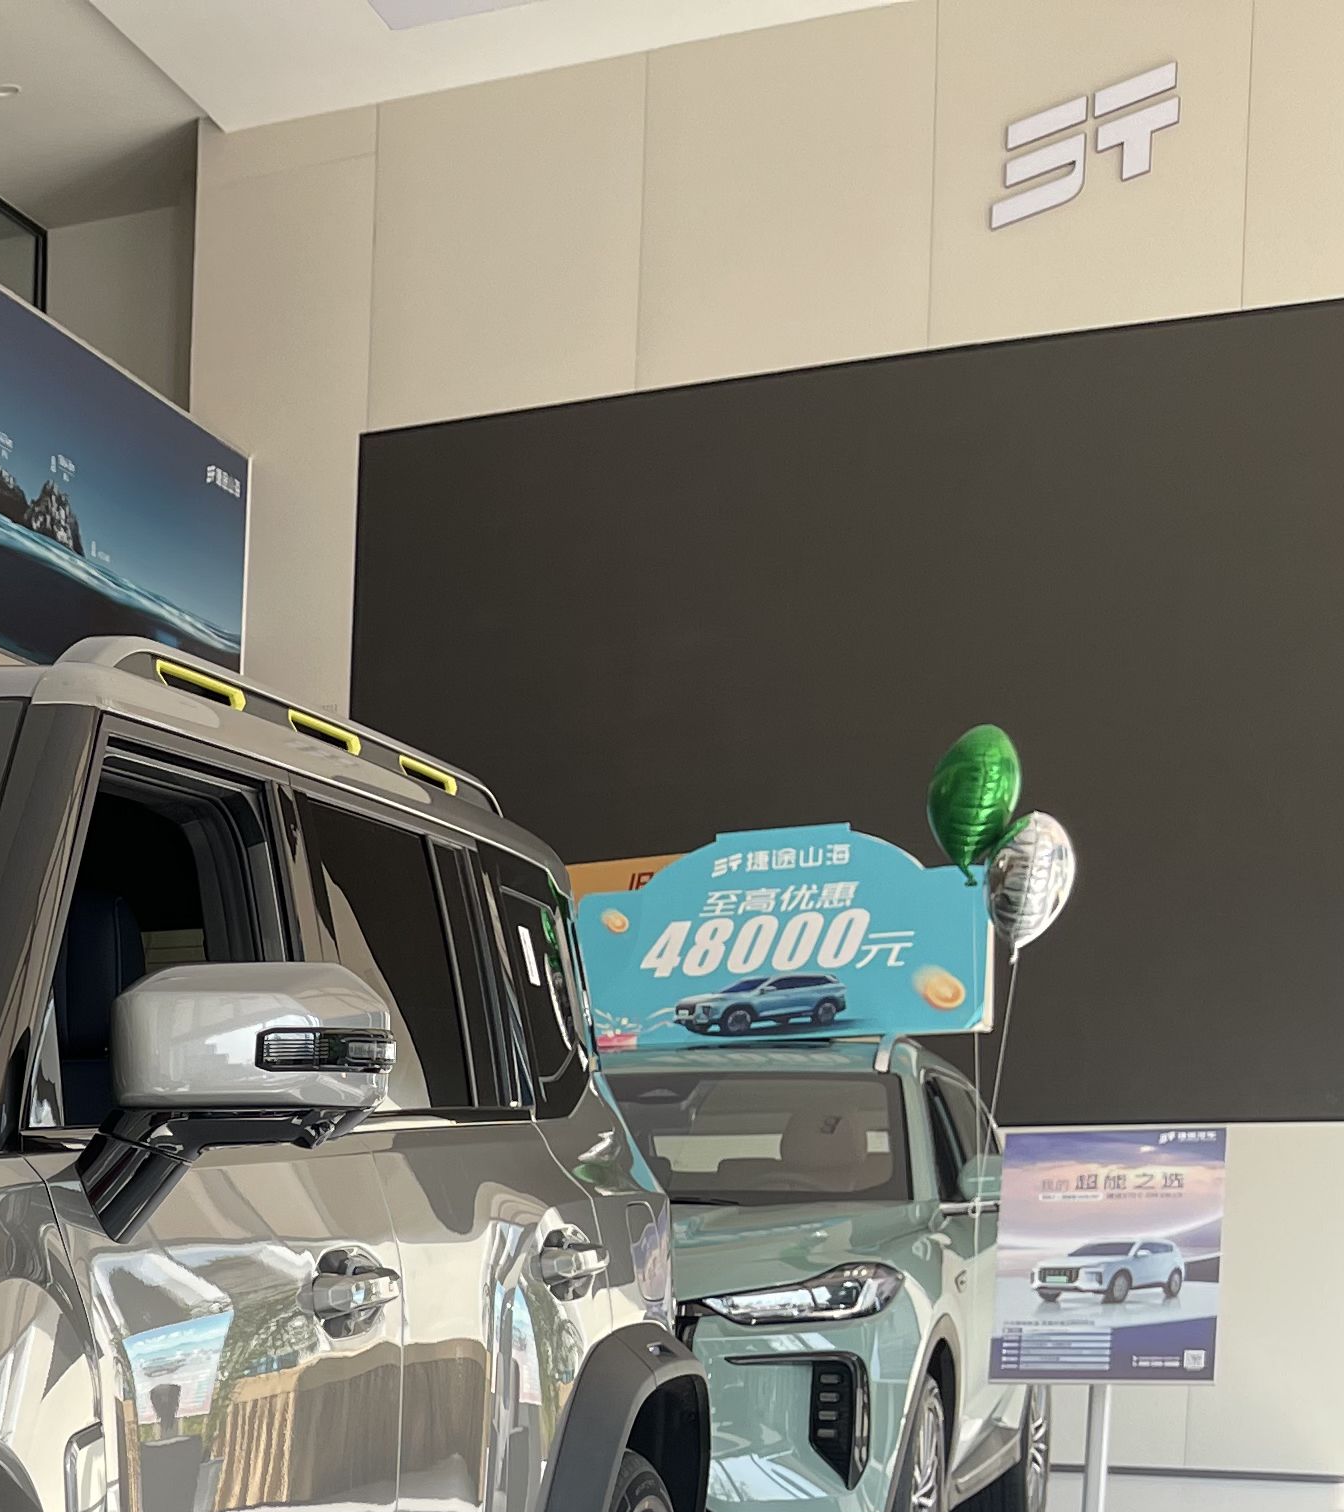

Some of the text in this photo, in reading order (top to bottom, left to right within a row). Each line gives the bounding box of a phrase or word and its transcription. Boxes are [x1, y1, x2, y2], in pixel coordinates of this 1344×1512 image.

[745, 843, 850, 872] 捷途山海
[698, 880, 860, 917] 至高优惠
[639, 907, 914, 979] 48000元
